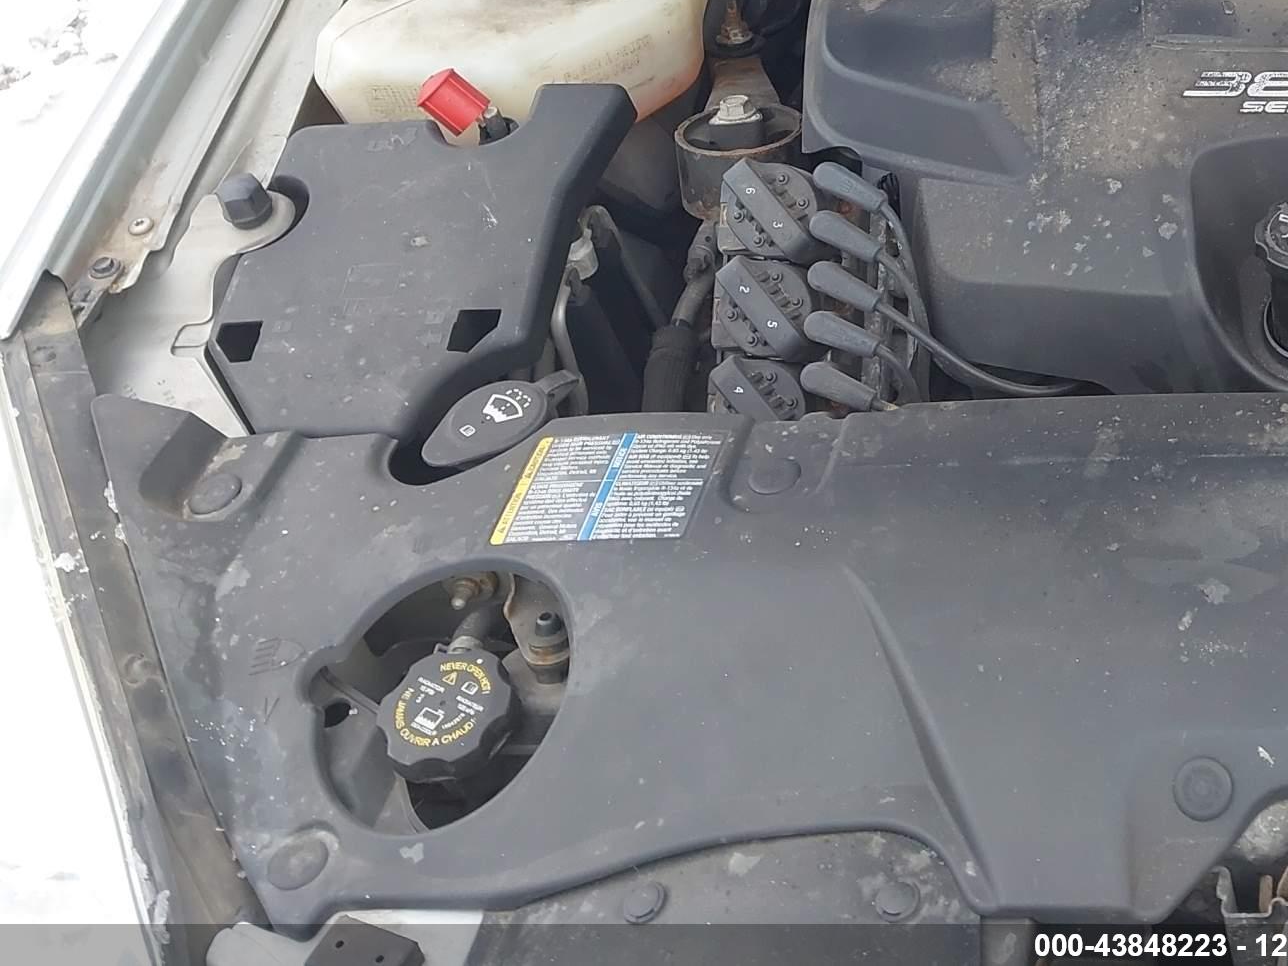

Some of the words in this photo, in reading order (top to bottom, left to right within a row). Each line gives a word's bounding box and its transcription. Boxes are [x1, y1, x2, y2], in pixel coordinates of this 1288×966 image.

[745, 187, 756, 195] 6
[772, 221, 783, 229] 3
[739, 285, 750, 294] 2
[767, 320, 778, 329] 5
[733, 386, 744, 394] 4
[440, 661, 467, 672] NEVER
